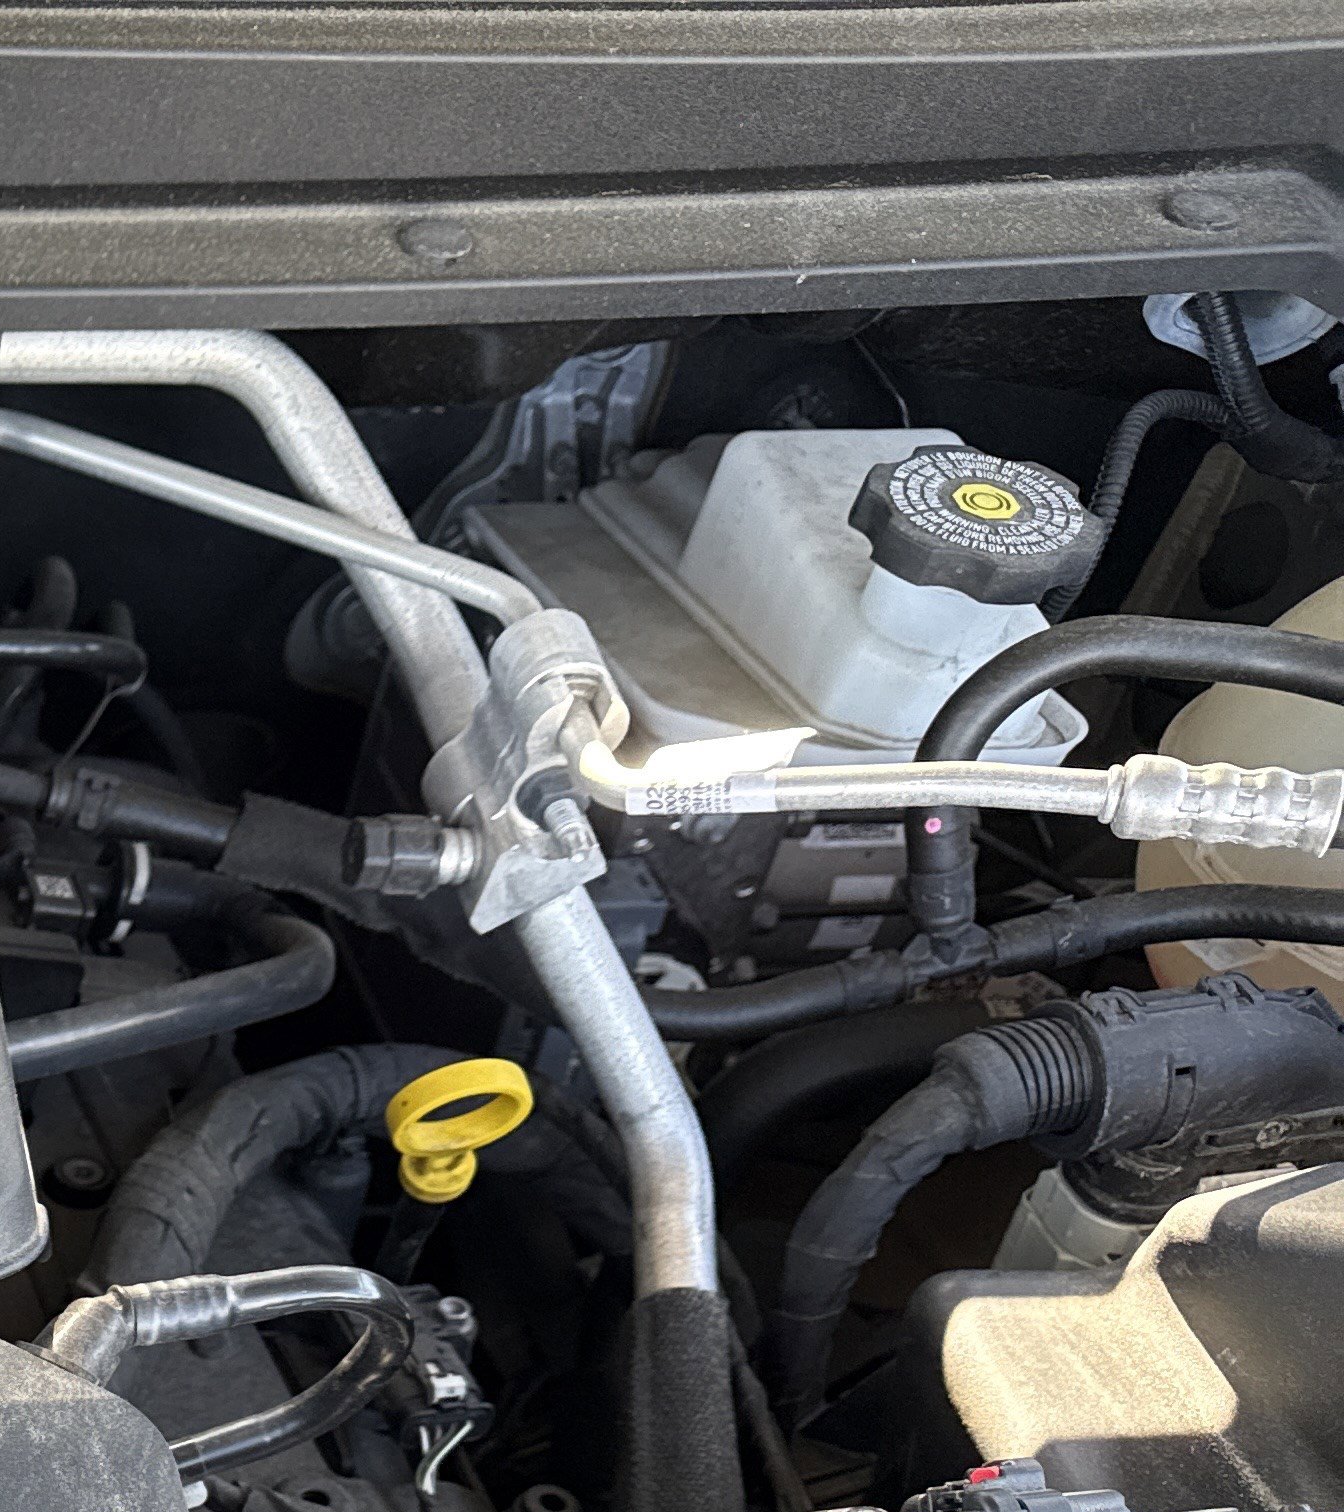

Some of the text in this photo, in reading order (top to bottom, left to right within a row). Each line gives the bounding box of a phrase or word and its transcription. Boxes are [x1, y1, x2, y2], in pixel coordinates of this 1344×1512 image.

[947, 452, 1002, 465] BOUCHON
[935, 528, 970, 546] FLUID
[972, 540, 1006, 553] FROM
[1009, 545, 1018, 554] A
[942, 521, 986, 541] BEFORE
